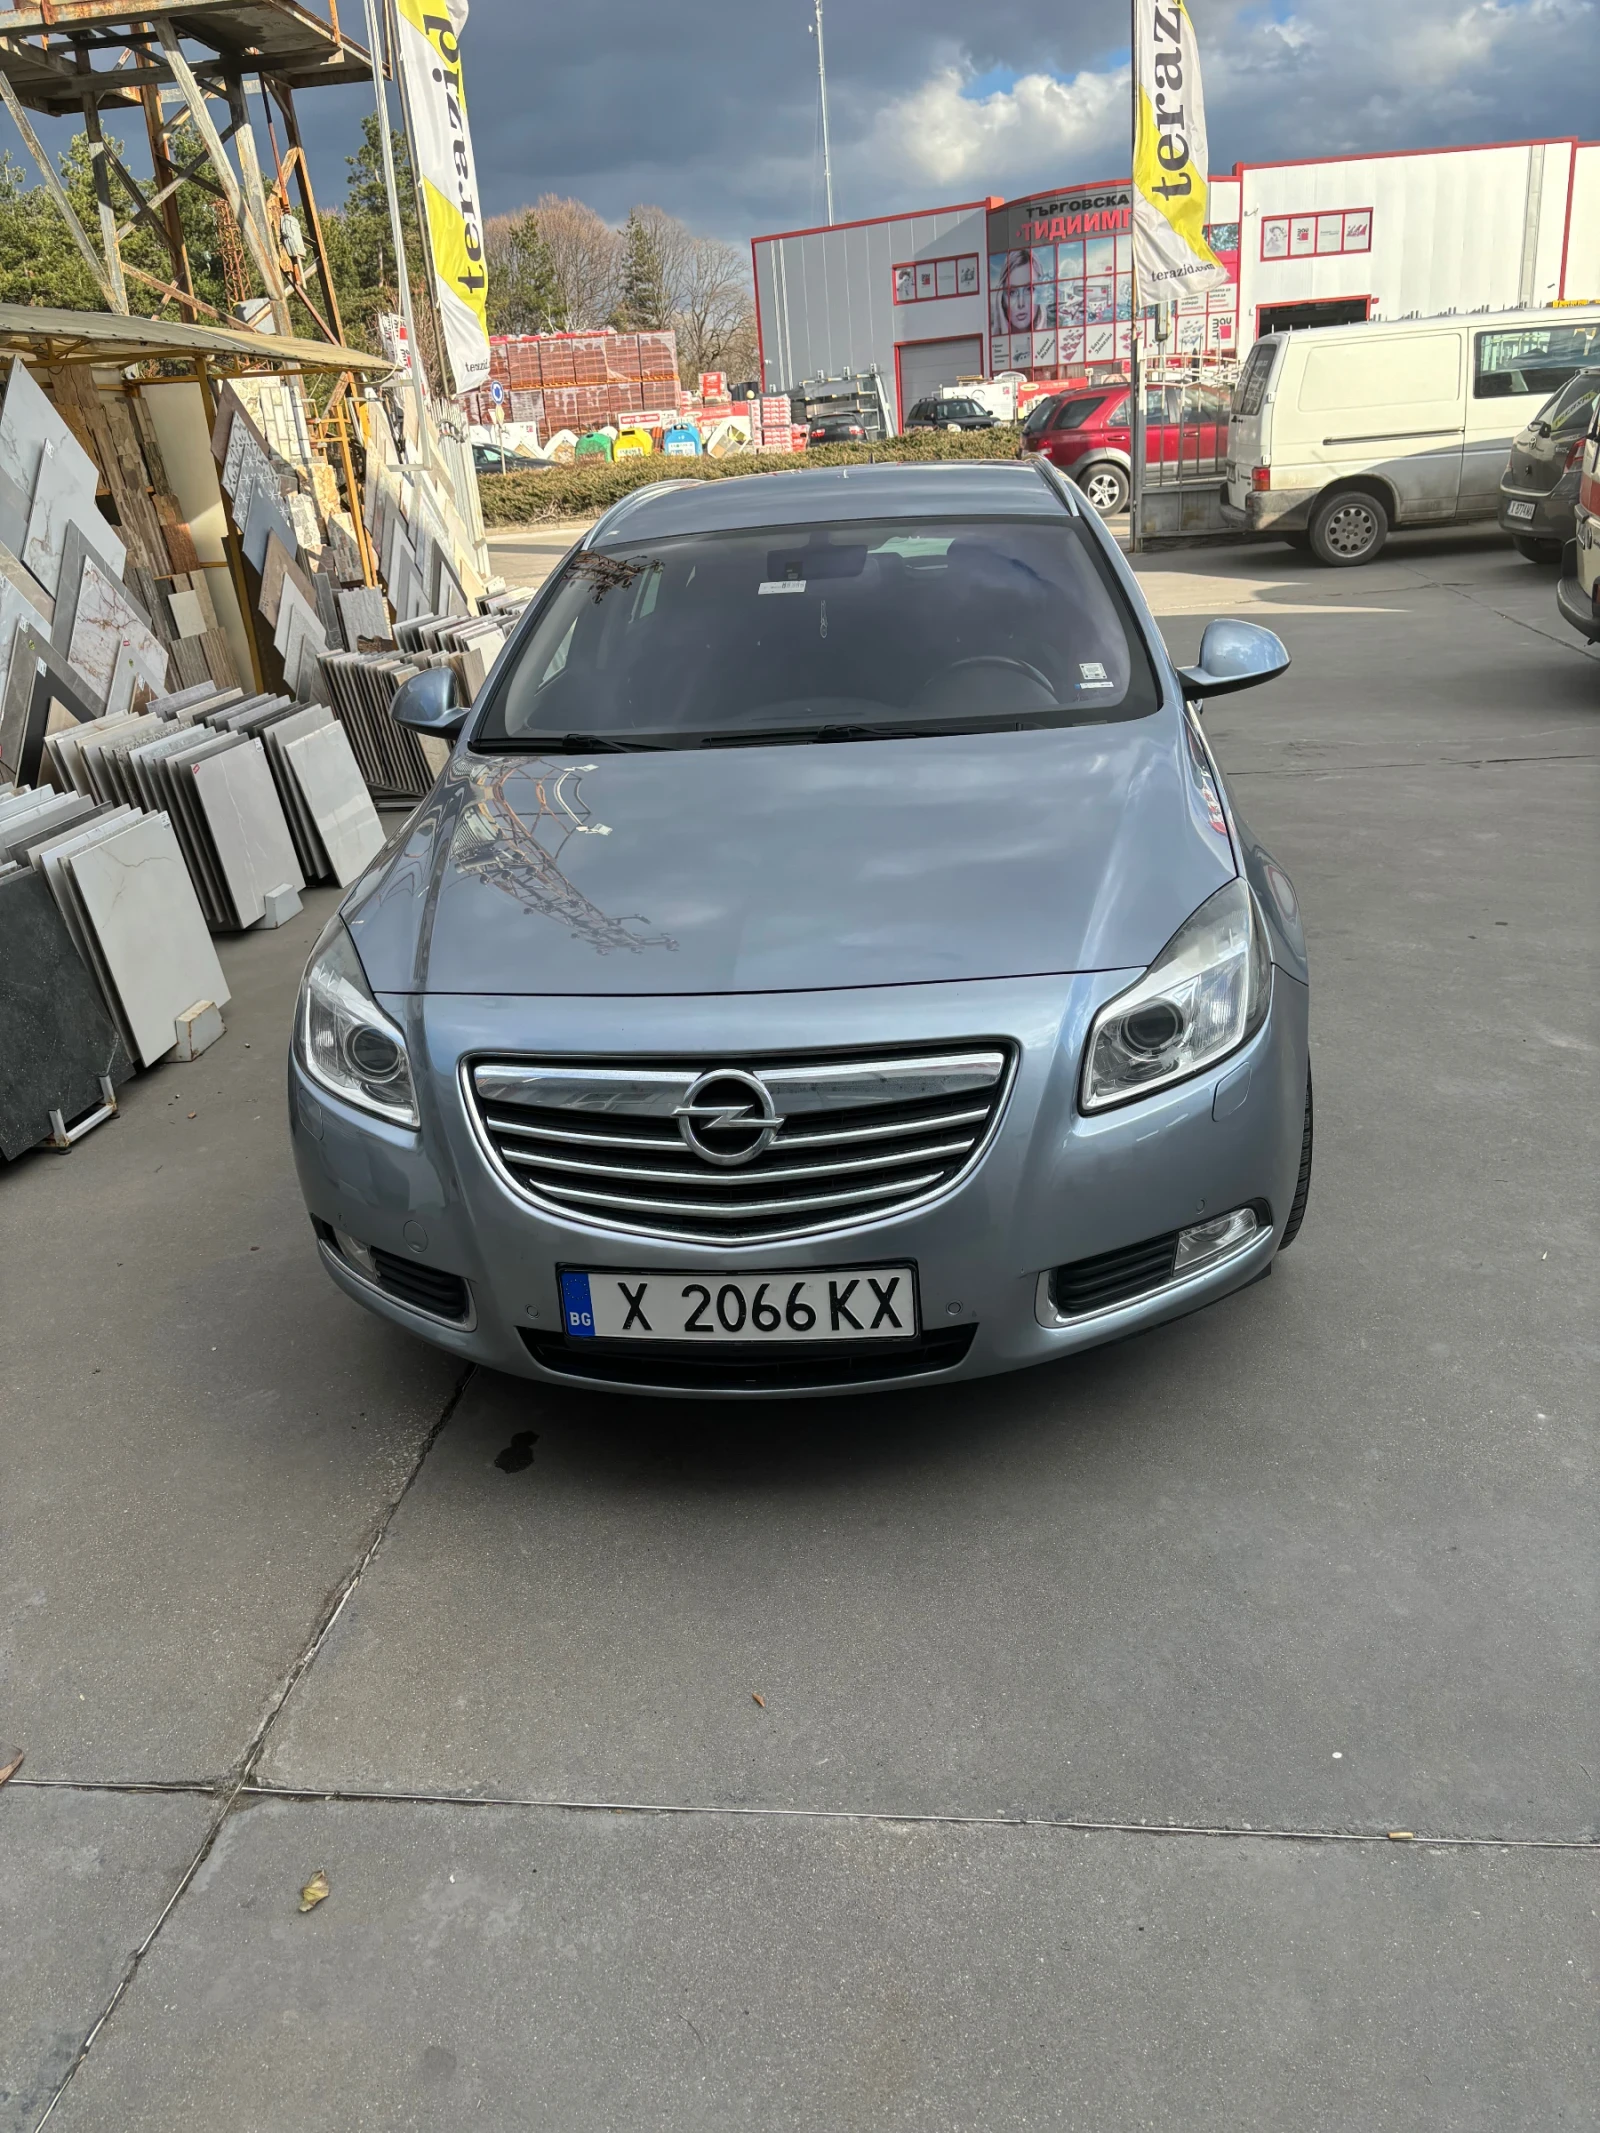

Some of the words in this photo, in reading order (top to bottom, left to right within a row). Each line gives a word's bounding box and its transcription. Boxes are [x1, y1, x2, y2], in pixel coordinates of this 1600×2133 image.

[1151, 0, 1192, 201] teraz
[1026, 194, 1130, 218] ТЪРГОВСКА
[569, 1311, 592, 1327] BG
[617, 1281, 653, 1331] X
